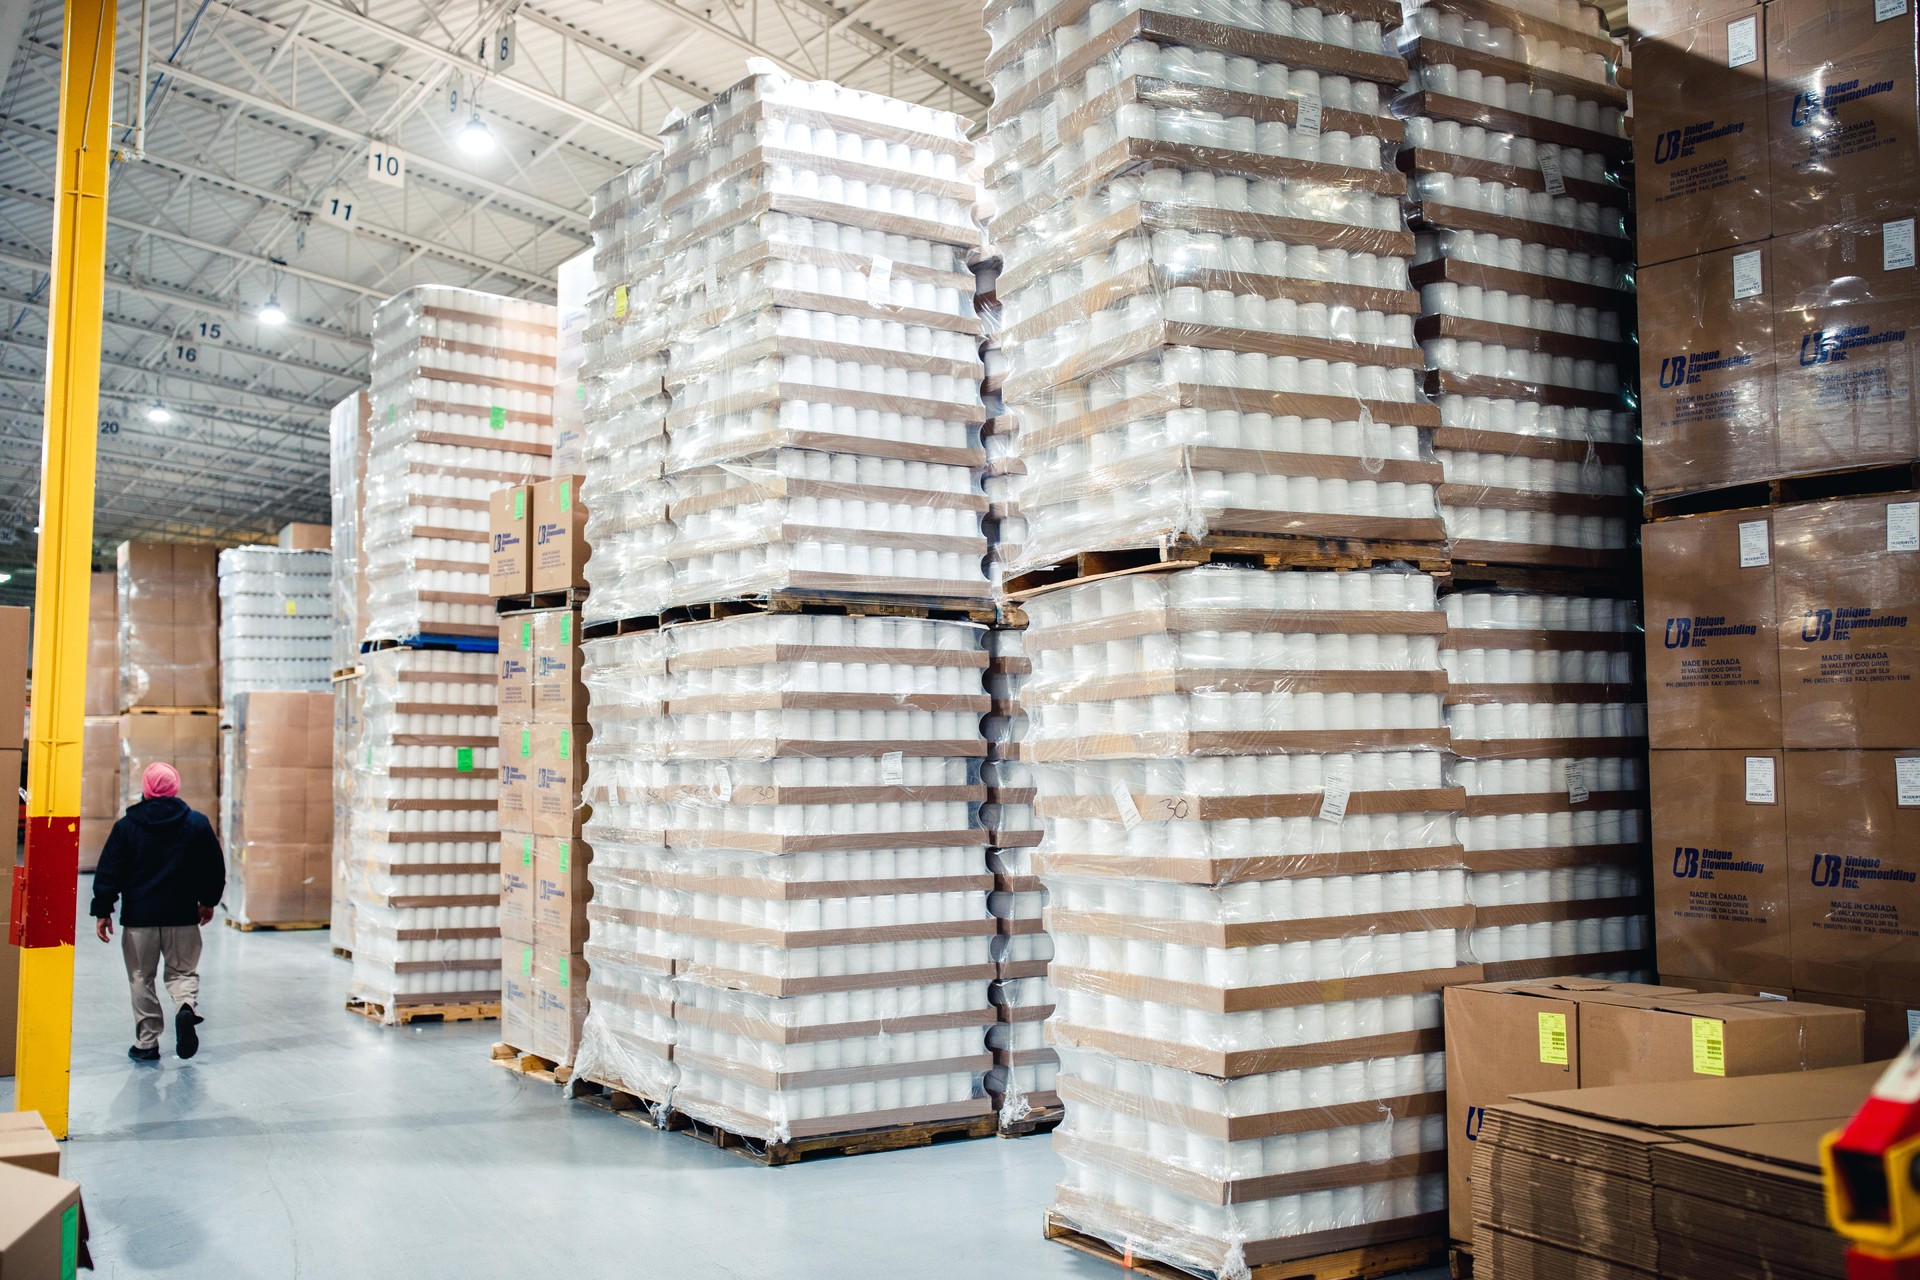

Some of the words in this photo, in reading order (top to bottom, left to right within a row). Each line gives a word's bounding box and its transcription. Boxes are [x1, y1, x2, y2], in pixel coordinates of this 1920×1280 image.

[500, 37, 509, 61] 8
[1823, 80, 1894, 108] Blowmoulding
[1825, 79, 1859, 96] Unique
[450, 90, 457, 113] 9
[1683, 122, 1744, 147] Blowmoulding
[1685, 121, 1714, 136] Unique
[1681, 147, 1695, 157] Inc.
[374, 153, 399, 176] 10
[331, 199, 352, 221] 11
[200, 321, 221, 339] 15
[1835, 325, 1869, 339] nique
[176, 345, 197, 363] 16
[1690, 351, 1719, 363] Unique
[1686, 374, 1701, 384] Inc.
[100, 420, 119, 435] 20
[1836, 607, 1871, 618] Unique
[1695, 616, 1725, 626] Unique
[1834, 616, 1907, 629] Blowmoulding
[1693, 625, 1756, 637] Blowmoulding
[1833, 630, 1850, 640] Inc.
[1692, 638, 1707, 647] Inc.
[1855, 652, 1888, 660] CANADA
[752, 786, 775, 800] 30
[1159, 798, 1188, 828] 30
[1703, 849, 1732, 860] Unique
[1701, 860, 1764, 873] Blowmoulding
[1846, 856, 1880, 868] Unique
[1700, 870, 1714, 879] Inc.
[1844, 867, 1916, 883] Blowmoulding
[1842, 878, 1859, 888] Inc.
[1719, 893, 1747, 901] CANADA
[1831, 901, 1852, 909] MADE
[1864, 903, 1897, 912] CANADA
[1466, 1106, 1486, 1141] U
